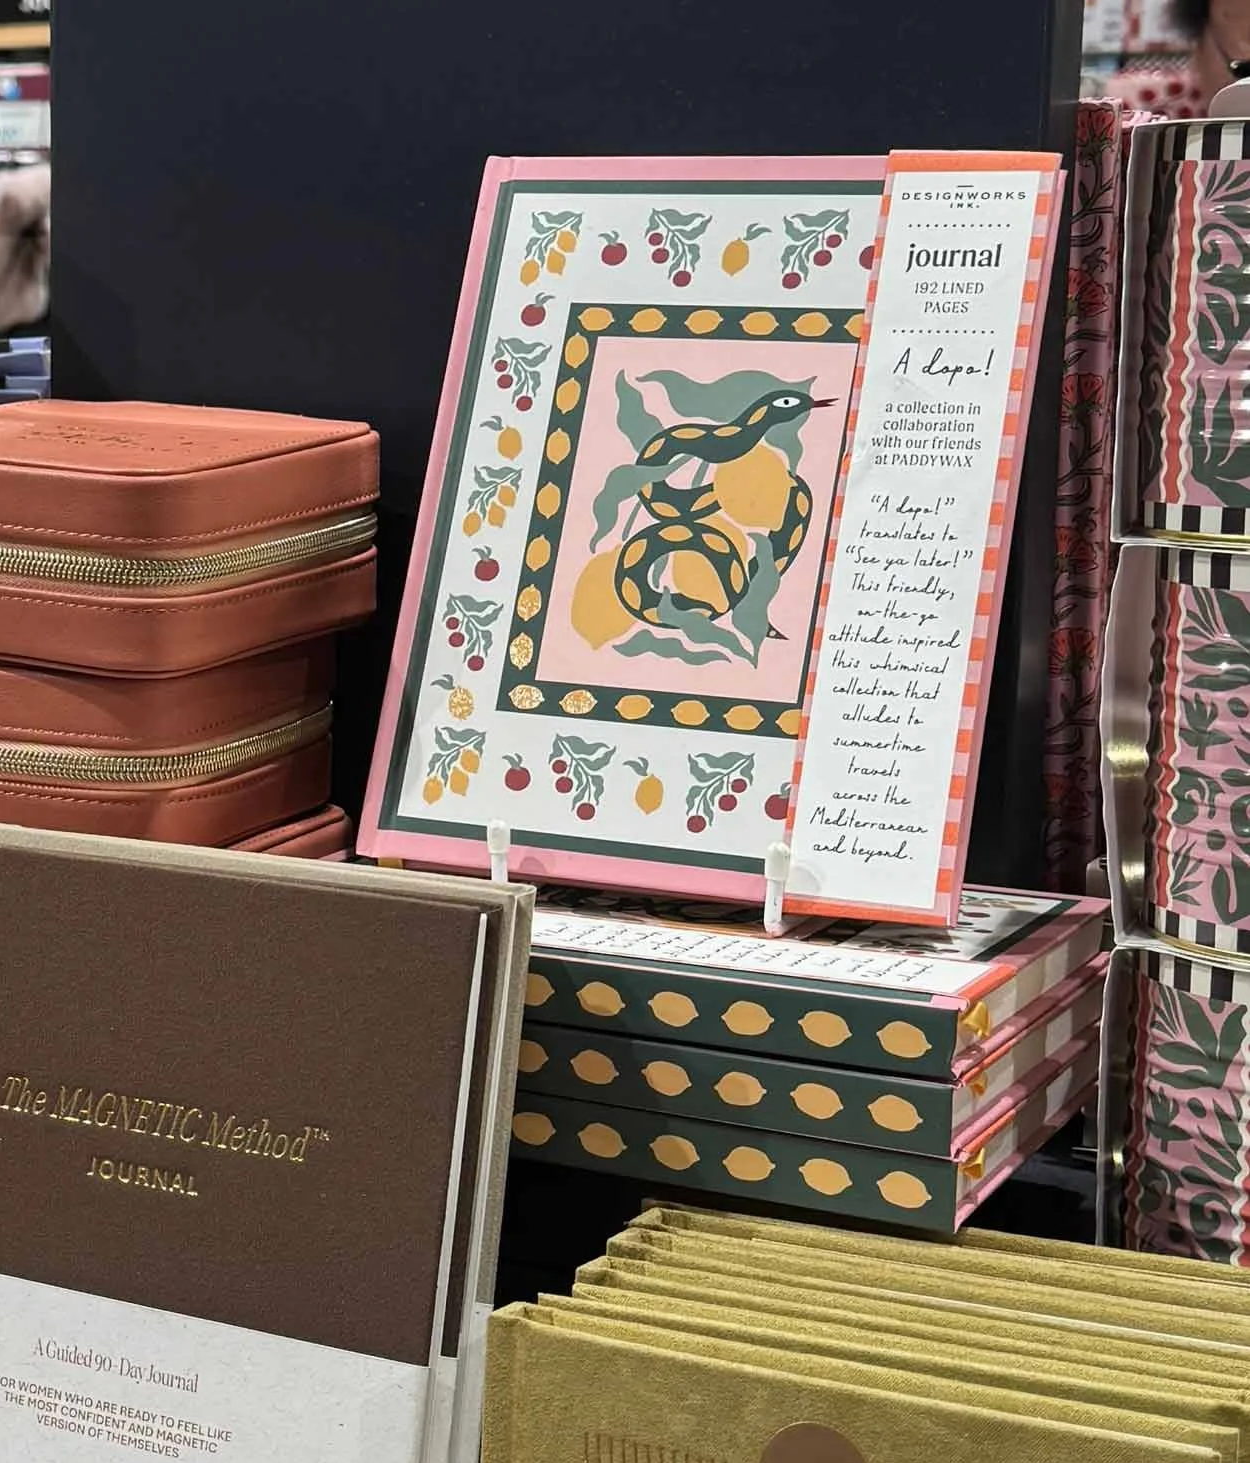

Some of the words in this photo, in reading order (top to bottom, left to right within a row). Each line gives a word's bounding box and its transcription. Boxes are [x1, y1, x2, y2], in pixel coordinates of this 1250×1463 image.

[902, 192, 1026, 200] DESIGNWORKS
[906, 243, 1003, 272] journal
[915, 281, 938, 294] 192
[942, 282, 984, 294] LINED
[924, 301, 970, 314] PAGES
[893, 347, 910, 374] A
[922, 347, 994, 386] dopo!
[885, 403, 893, 413] a
[897, 401, 964, 415] collection
[968, 403, 981, 415] in
[883, 419, 975, 432] collaboration
[871, 435, 901, 449] with
[905, 439, 928, 449] our
[932, 436, 982, 450] friends
[874, 454, 887, 465] at
[891, 453, 974, 468] PADDYWAX
[860, 520, 935, 541] translates
[942, 523, 958, 541] to
[884, 559, 910, 571] ya
[852, 572, 880, 592] This
[886, 574, 954, 601] friendly,
[857, 600, 939, 626] on-the-go
[828, 624, 893, 644] attitude
[897, 630, 961, 652] inspired
[832, 650, 860, 669] this
[870, 651, 949, 674] whimsical
[833, 677, 900, 697] collection
[905, 680, 940, 700] that
[842, 703, 900, 724] alludes
[908, 707, 923, 725] to
[833, 733, 926, 752] summertime
[847, 756, 900, 777] travels
[832, 791, 877, 802] across
[884, 785, 911, 805] the
[810, 807, 928, 833] Mediterranean
[813, 835, 846, 853] and
[851, 836, 914, 863] beyond.
[0, 1076, 47, 1115] The
[49, 1085, 202, 1143] MAGNETIC
[86, 1156, 199, 1196] JOURNAL
[34, 1338, 44, 1356] A
[46, 1339, 92, 1369] Guided
[146, 1364, 199, 1393] Journal
[4, 1391, 25, 1405] THE
[27, 1396, 58, 1413] MOST
[60, 1402, 126, 1431] CONFIDENT
[128, 1421, 154, 1438] AND
[156, 1430, 218, 1454] MAGNETIC
[18, 1380, 62, 1401] WOMEN
[65, 1391, 93, 1408] WHO
[95, 1400, 118, 1415] ARE
[120, 1405, 158, 1424] READY
[161, 1415, 174, 1428] TO
[177, 1420, 204, 1436] FEEL
[207, 1427, 232, 1442] LIKE
[37, 1414, 85, 1436] VERSION
[88, 1427, 103, 1438] OF
[106, 1431, 179, 1458] THEMSELVES
